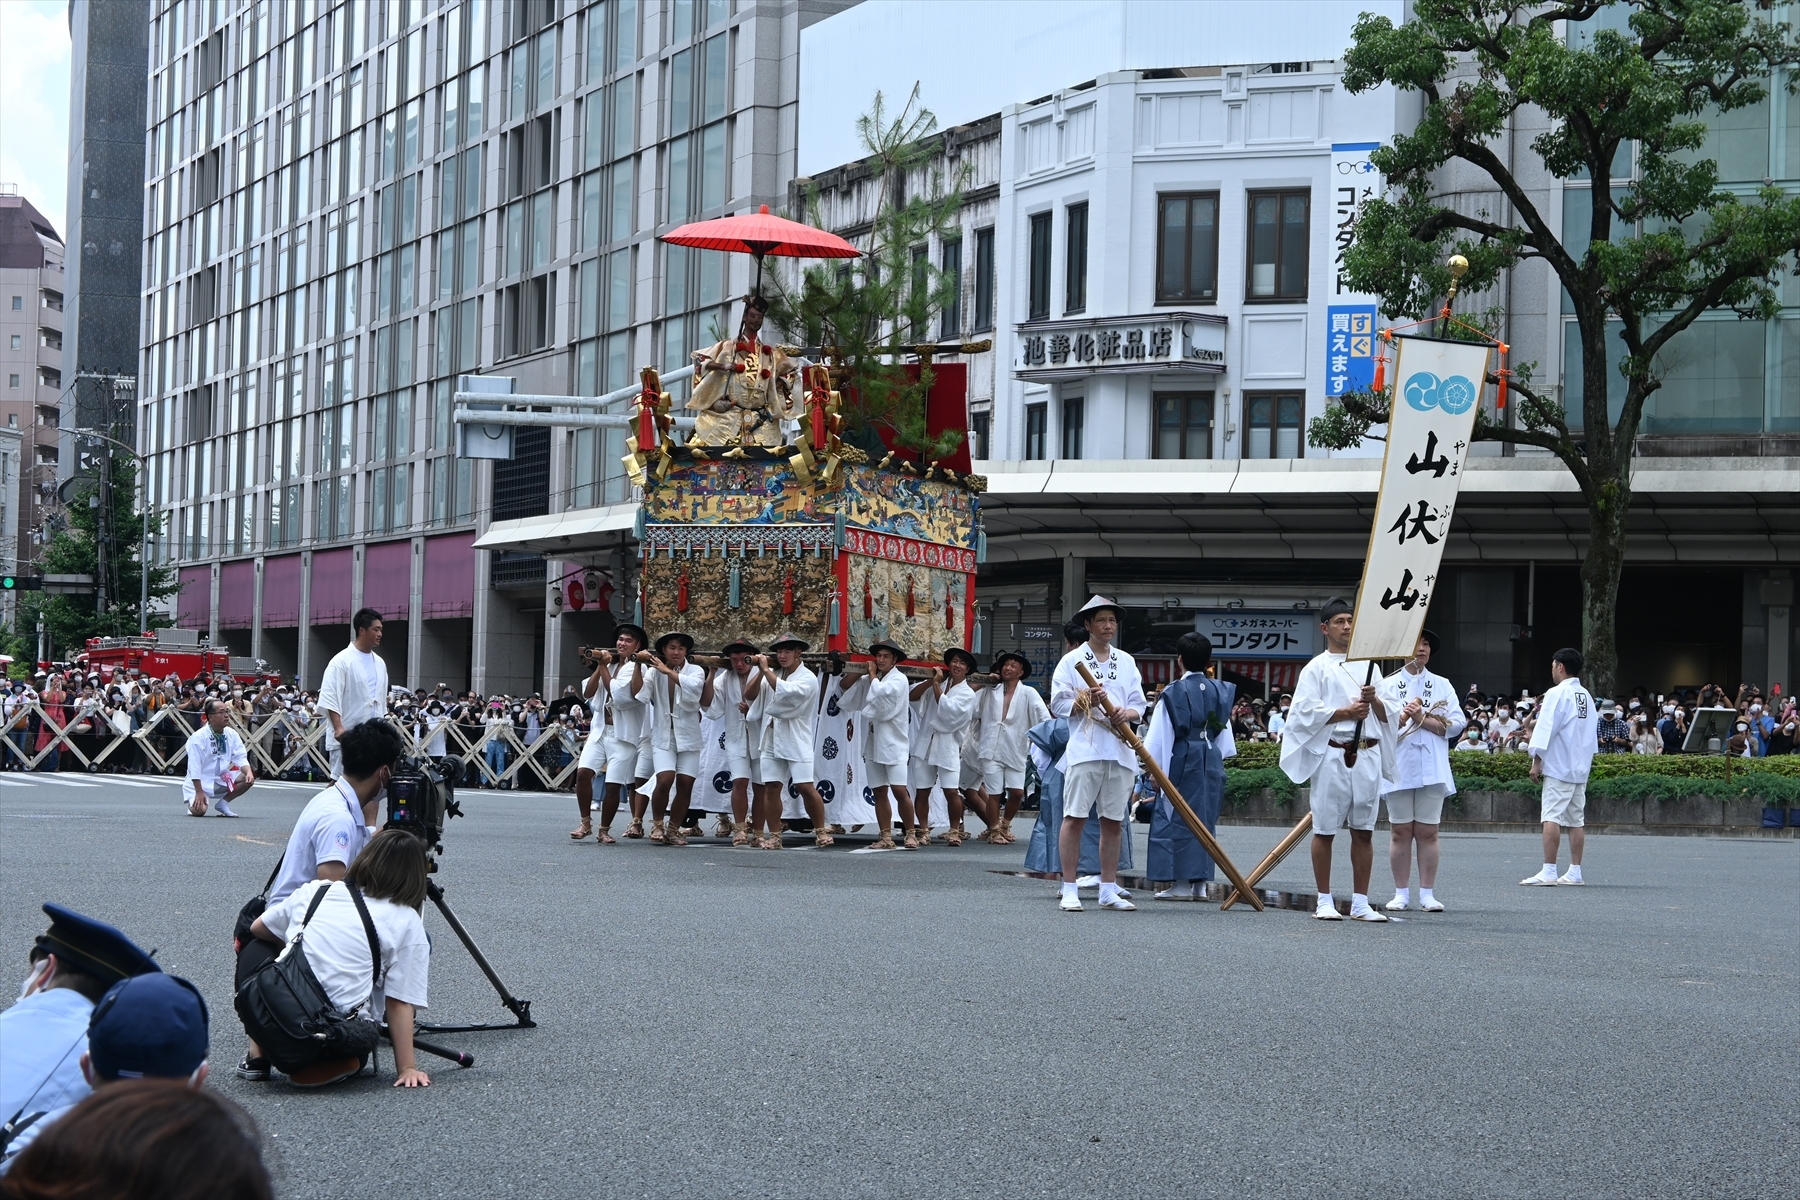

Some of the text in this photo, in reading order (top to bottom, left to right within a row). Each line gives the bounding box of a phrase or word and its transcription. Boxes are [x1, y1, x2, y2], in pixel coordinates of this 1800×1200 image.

[1023, 326, 1172, 366] 池善化粧品店
[1331, 313, 1350, 393] 買えます
[1353, 315, 1370, 356] すぐ
[1380, 430, 1450, 611] 山伏山
[1024, 631, 1053, 639] コンタクト
[1211, 632, 1299, 651] コンタクト
[1240, 618, 1299, 629] メガネスーパー
